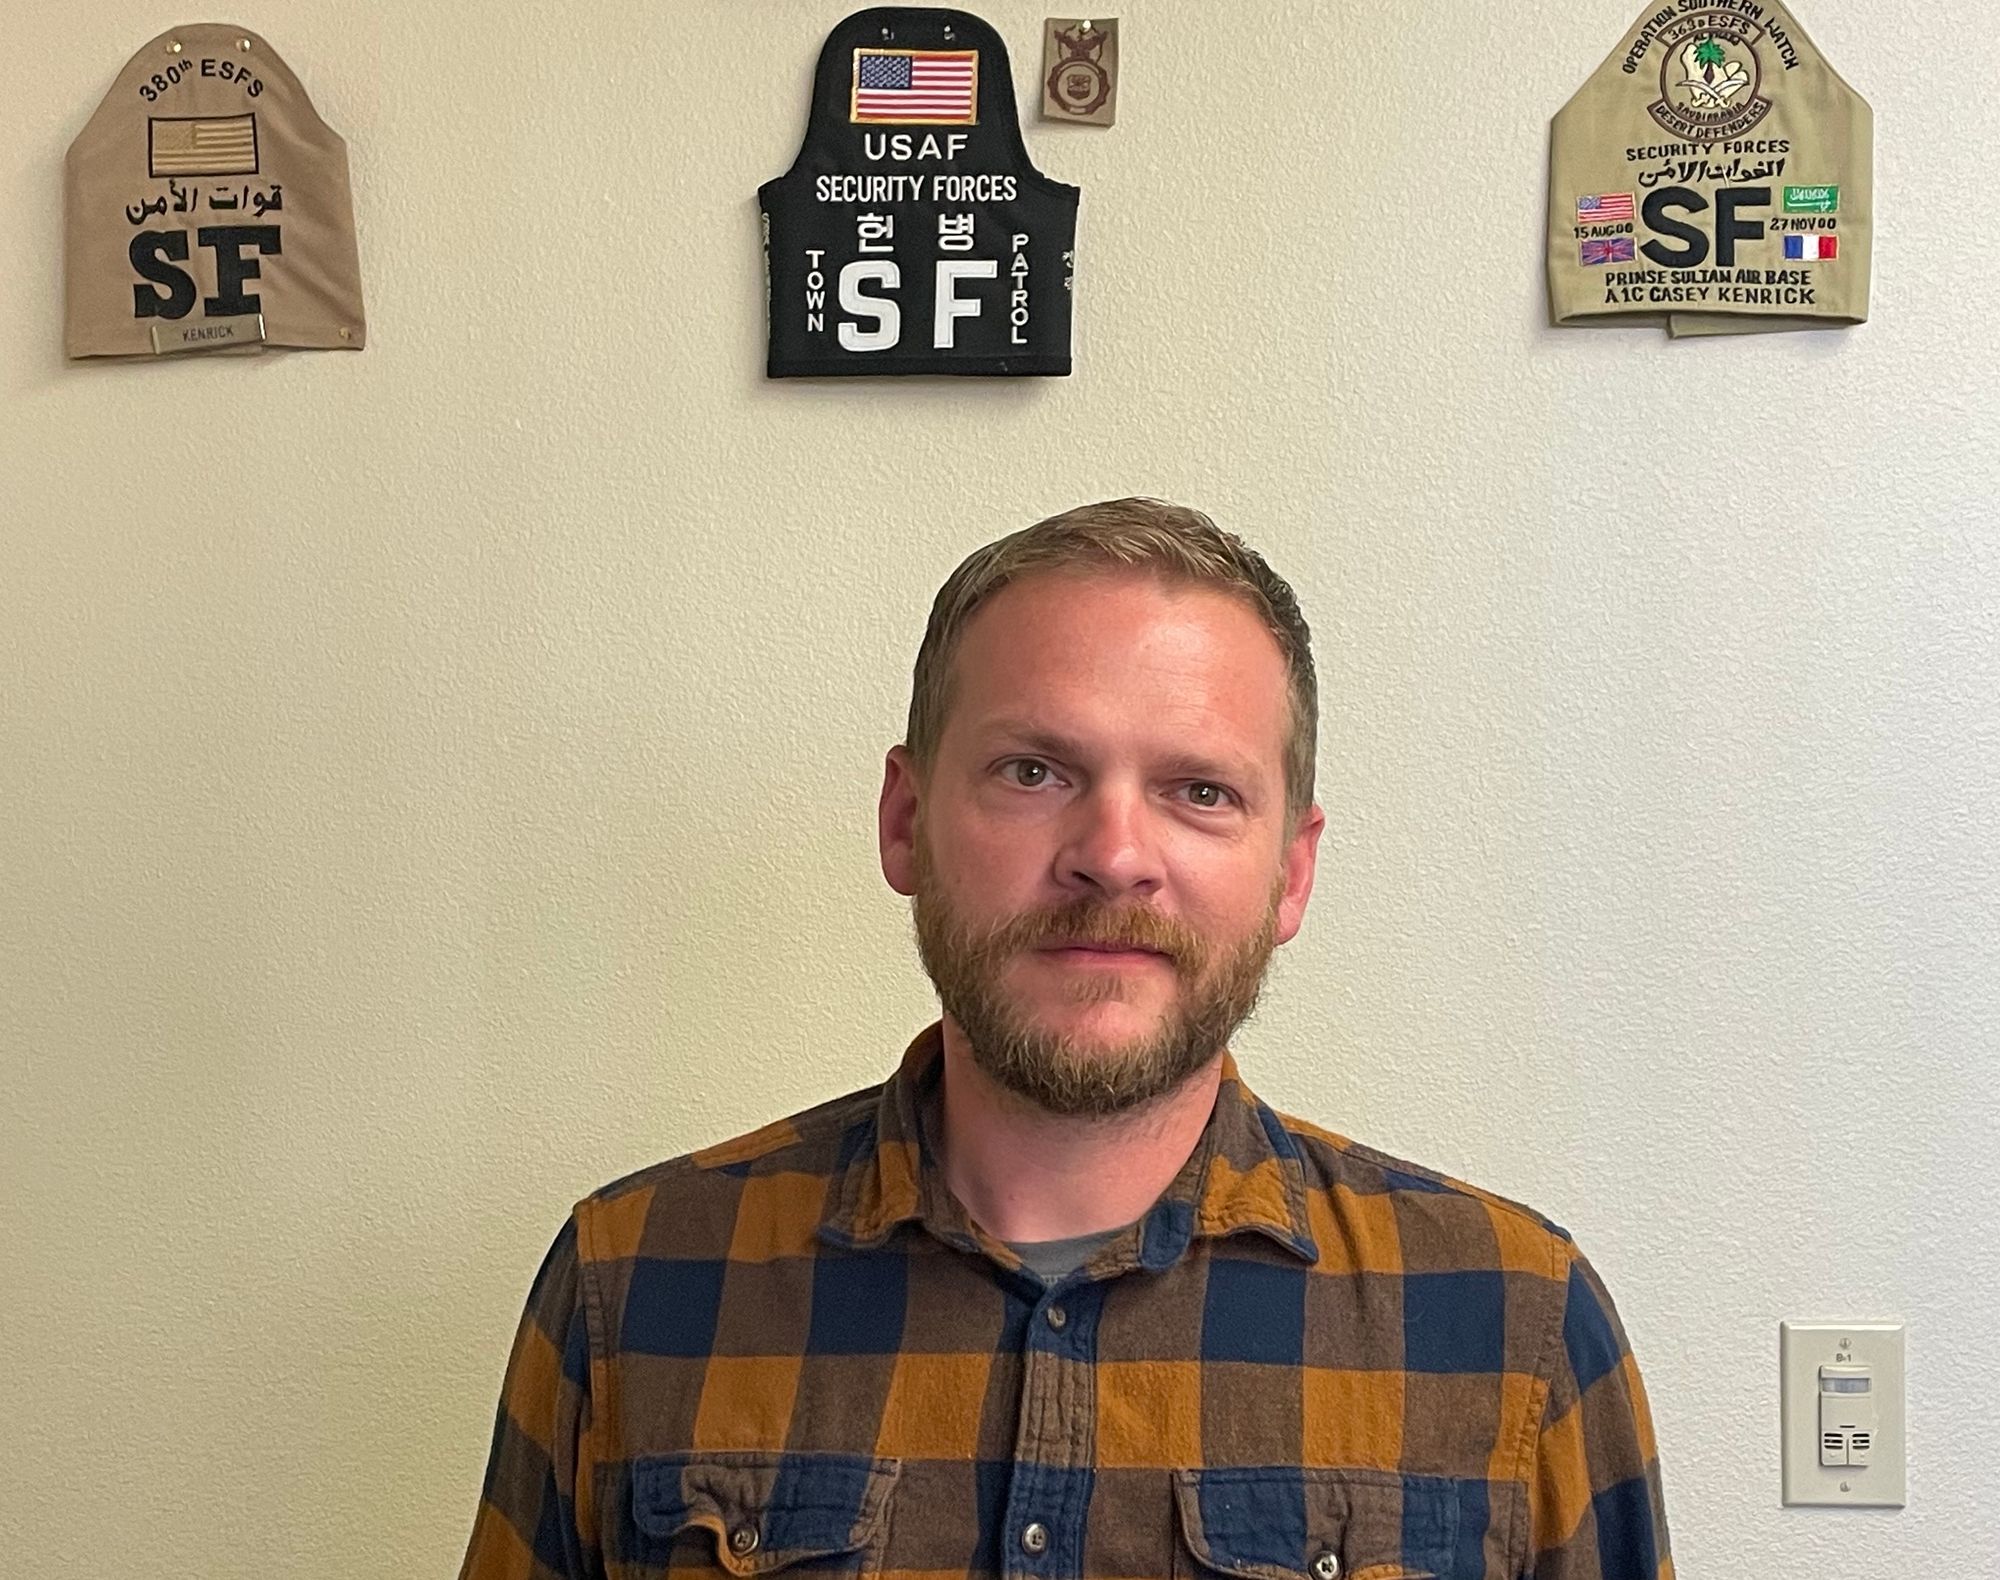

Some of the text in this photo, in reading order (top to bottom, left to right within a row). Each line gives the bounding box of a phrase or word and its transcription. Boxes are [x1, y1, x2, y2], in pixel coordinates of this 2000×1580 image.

[1622, 5, 1677, 74] OPERATION
[1764, 16, 1799, 71] WATCH
[1708, 15, 1750, 35] ESFS
[139, 58, 264, 102] 380th ESFS
[1655, 102, 1765, 139] DESERT DEFENDERS
[864, 133, 968, 161] USAF
[1626, 140, 1790, 162] SECURITY FORCES
[125, 178, 283, 226] قوات الأمن
[816, 174, 1017, 202] SECURITY FORCES
[1640, 186, 1771, 268] SF
[129, 225, 282, 320] SF
[805, 250, 825, 332] TOWN
[1011, 233, 1029, 344] PATROL
[1605, 268, 1812, 286] PRINSE SULTAN AIR BASE
[1649, 286, 1710, 303] CASEY
[1718, 287, 1816, 305] KENRICK
[182, 325, 234, 342] KENRICK
